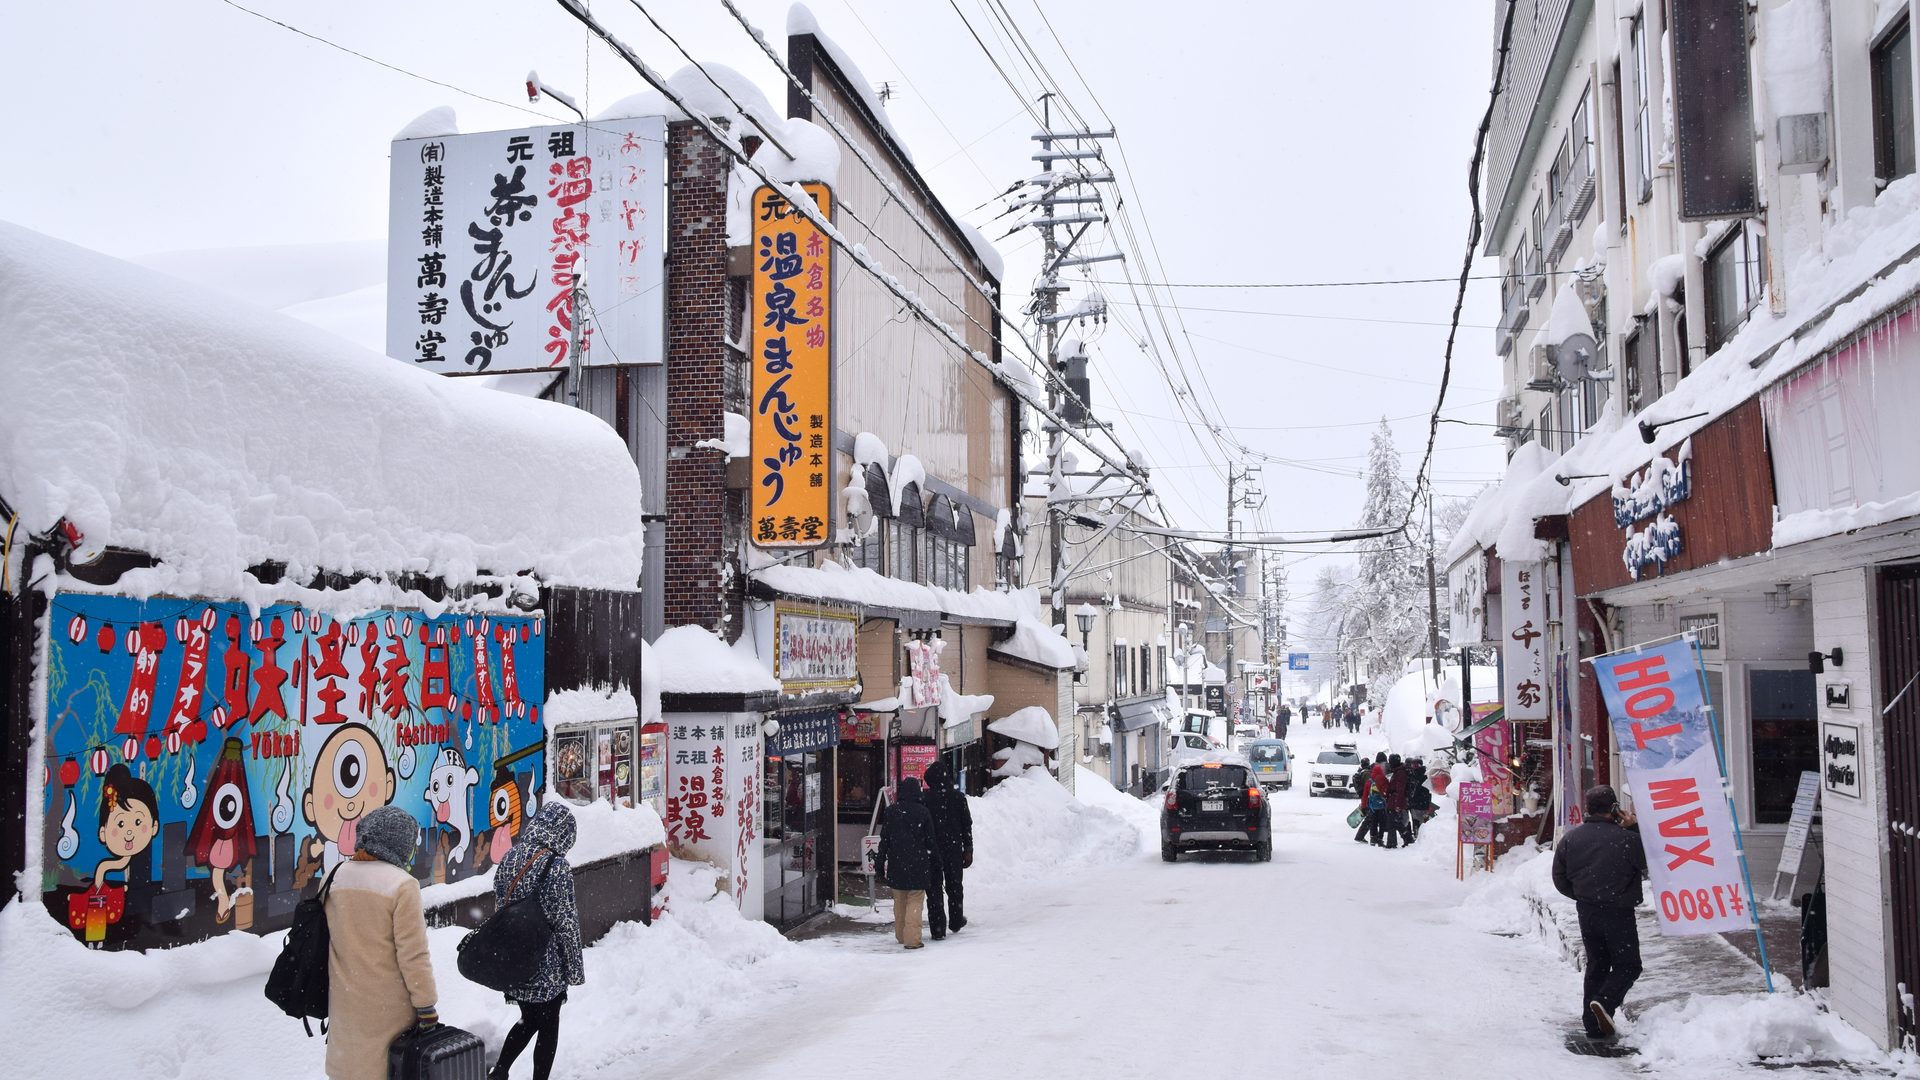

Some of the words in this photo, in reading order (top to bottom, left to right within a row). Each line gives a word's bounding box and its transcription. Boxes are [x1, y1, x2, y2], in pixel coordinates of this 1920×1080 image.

[507, 131, 576, 163] 元祖
[459, 165, 539, 373] 茶まんじゅう
[804, 230, 826, 350] 赤倉名物
[414, 254, 450, 364] 萬壽堂
[759, 231, 810, 508] 温泉まんじゅう
[809, 414, 824, 489] 製造本舗
[756, 515, 825, 543] 萬壽堂
[1518, 570, 1531, 611] ほてる
[128, 645, 158, 716] 射的
[223, 633, 452, 729] 妖怪縁日
[396, 721, 450, 748] Festival
[667, 725, 725, 741] 造本舗
[675, 750, 708, 765] 元祖
[742, 745, 754, 763] 元祖
[679, 775, 712, 845] 温泉
[711, 745, 725, 818] 赤倉名物
[743, 774, 756, 845] 温泉
[1461, 787, 1491, 796] もちもち
